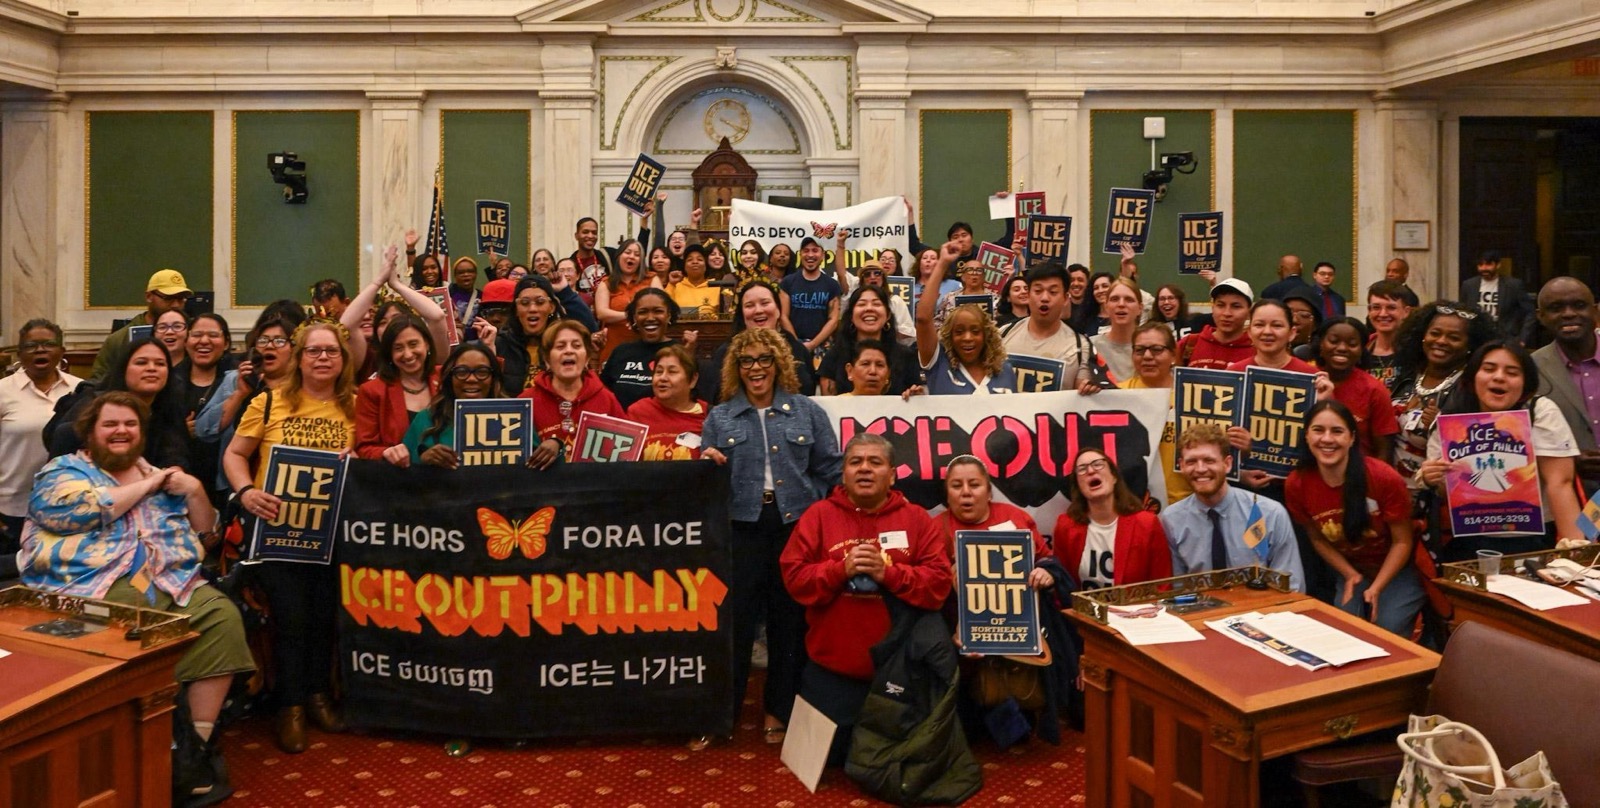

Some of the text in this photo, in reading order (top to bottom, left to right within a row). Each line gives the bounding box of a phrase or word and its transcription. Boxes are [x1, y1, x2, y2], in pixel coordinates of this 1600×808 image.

[635, 161, 660, 185] ICE
[629, 177, 653, 198] OUT
[480, 207, 506, 225] ICE
[1018, 199, 1042, 216] ICE
[1116, 197, 1148, 218] ICE
[480, 224, 507, 239] OUT
[731, 226, 806, 238] GLAS DEYO
[1032, 221, 1066, 240] ICE
[1111, 218, 1146, 236] OUT
[1183, 218, 1218, 239] ICE
[1030, 240, 1065, 258] OUT
[1182, 239, 1218, 256] OUT
[981, 250, 1009, 271] ICE
[983, 268, 1004, 286] UT
[624, 361, 645, 371] PA
[1011, 366, 1054, 393] CE
[1182, 382, 1235, 417] ICE
[1253, 382, 1307, 419] ICE
[285, 416, 345, 428] NATIONAL
[464, 413, 521, 447] ICE
[1249, 415, 1305, 448] OUT
[281, 437, 347, 448] ALLIANCE
[969, 411, 1132, 479] OUT
[1470, 428, 1495, 442] ICE
[1249, 451, 1299, 467] PHILLY
[1267, 446, 1283, 455] OF
[1448, 441, 1526, 460] OUT OF PHILLY
[273, 463, 335, 500] ICE
[267, 501, 330, 530] OUT
[1464, 514, 1531, 525] 814-205-3293
[265, 537, 322, 550] PHILLY
[287, 530, 303, 538] OF
[343, 520, 465, 553] ICE HORS
[563, 521, 703, 550] FORA ICE
[964, 543, 1025, 579] ICE
[1088, 549, 1115, 580] IC
[340, 563, 712, 620] ICE OUT PHILLY
[964, 583, 1028, 615] OUT
[990, 617, 1007, 626] OF
[970, 632, 1029, 642] PHILLY
[351, 650, 391, 677] ICE
[540, 655, 707, 687] ICE는 나가라
